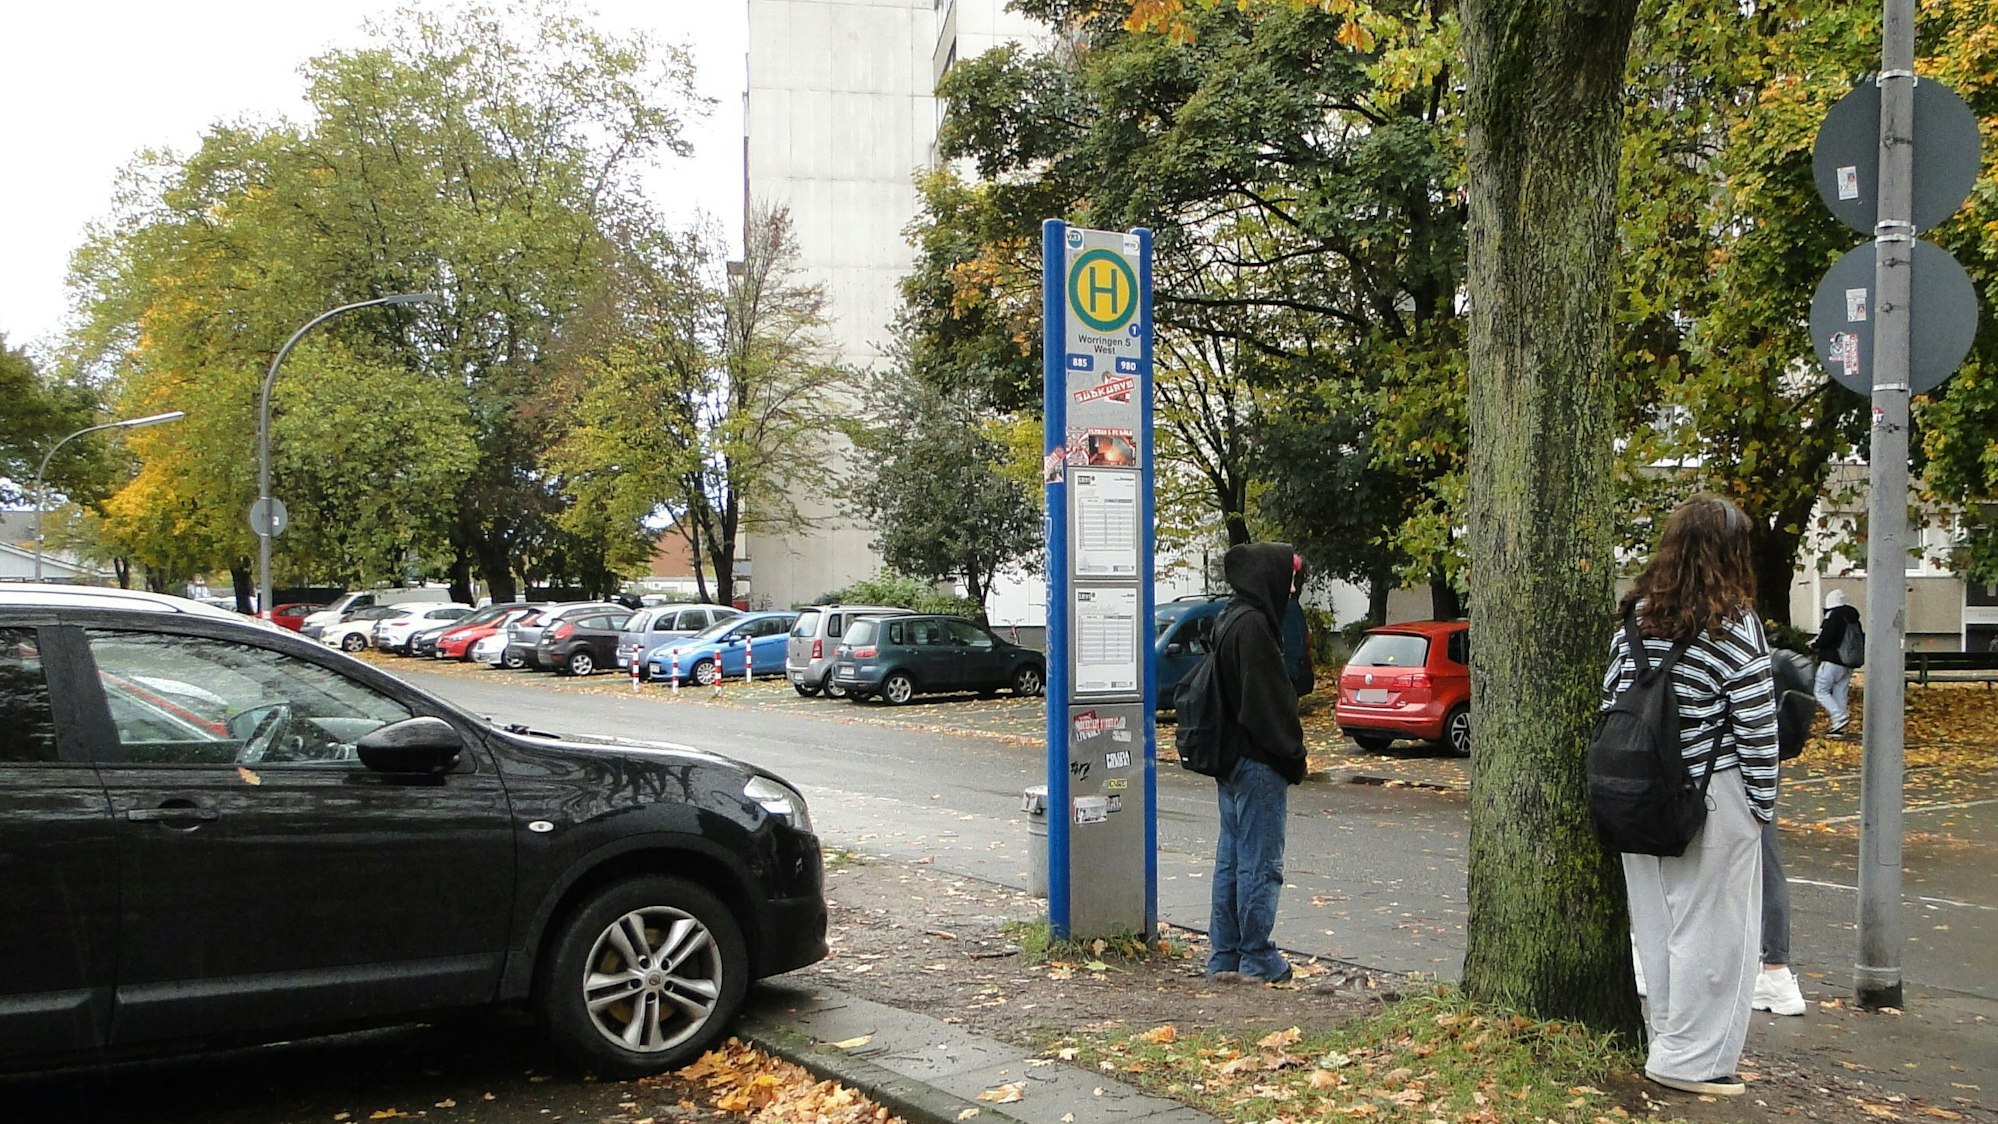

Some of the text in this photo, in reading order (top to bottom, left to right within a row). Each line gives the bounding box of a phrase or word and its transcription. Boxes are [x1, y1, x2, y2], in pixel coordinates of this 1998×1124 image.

[1089, 266, 1118, 314] H
[1131, 326, 1137, 335] 1
[1078, 334, 1131, 346] Worringen S
[1094, 345, 1116, 355] West
[1072, 358, 1088, 367] 885
[1121, 361, 1136, 371] 980
